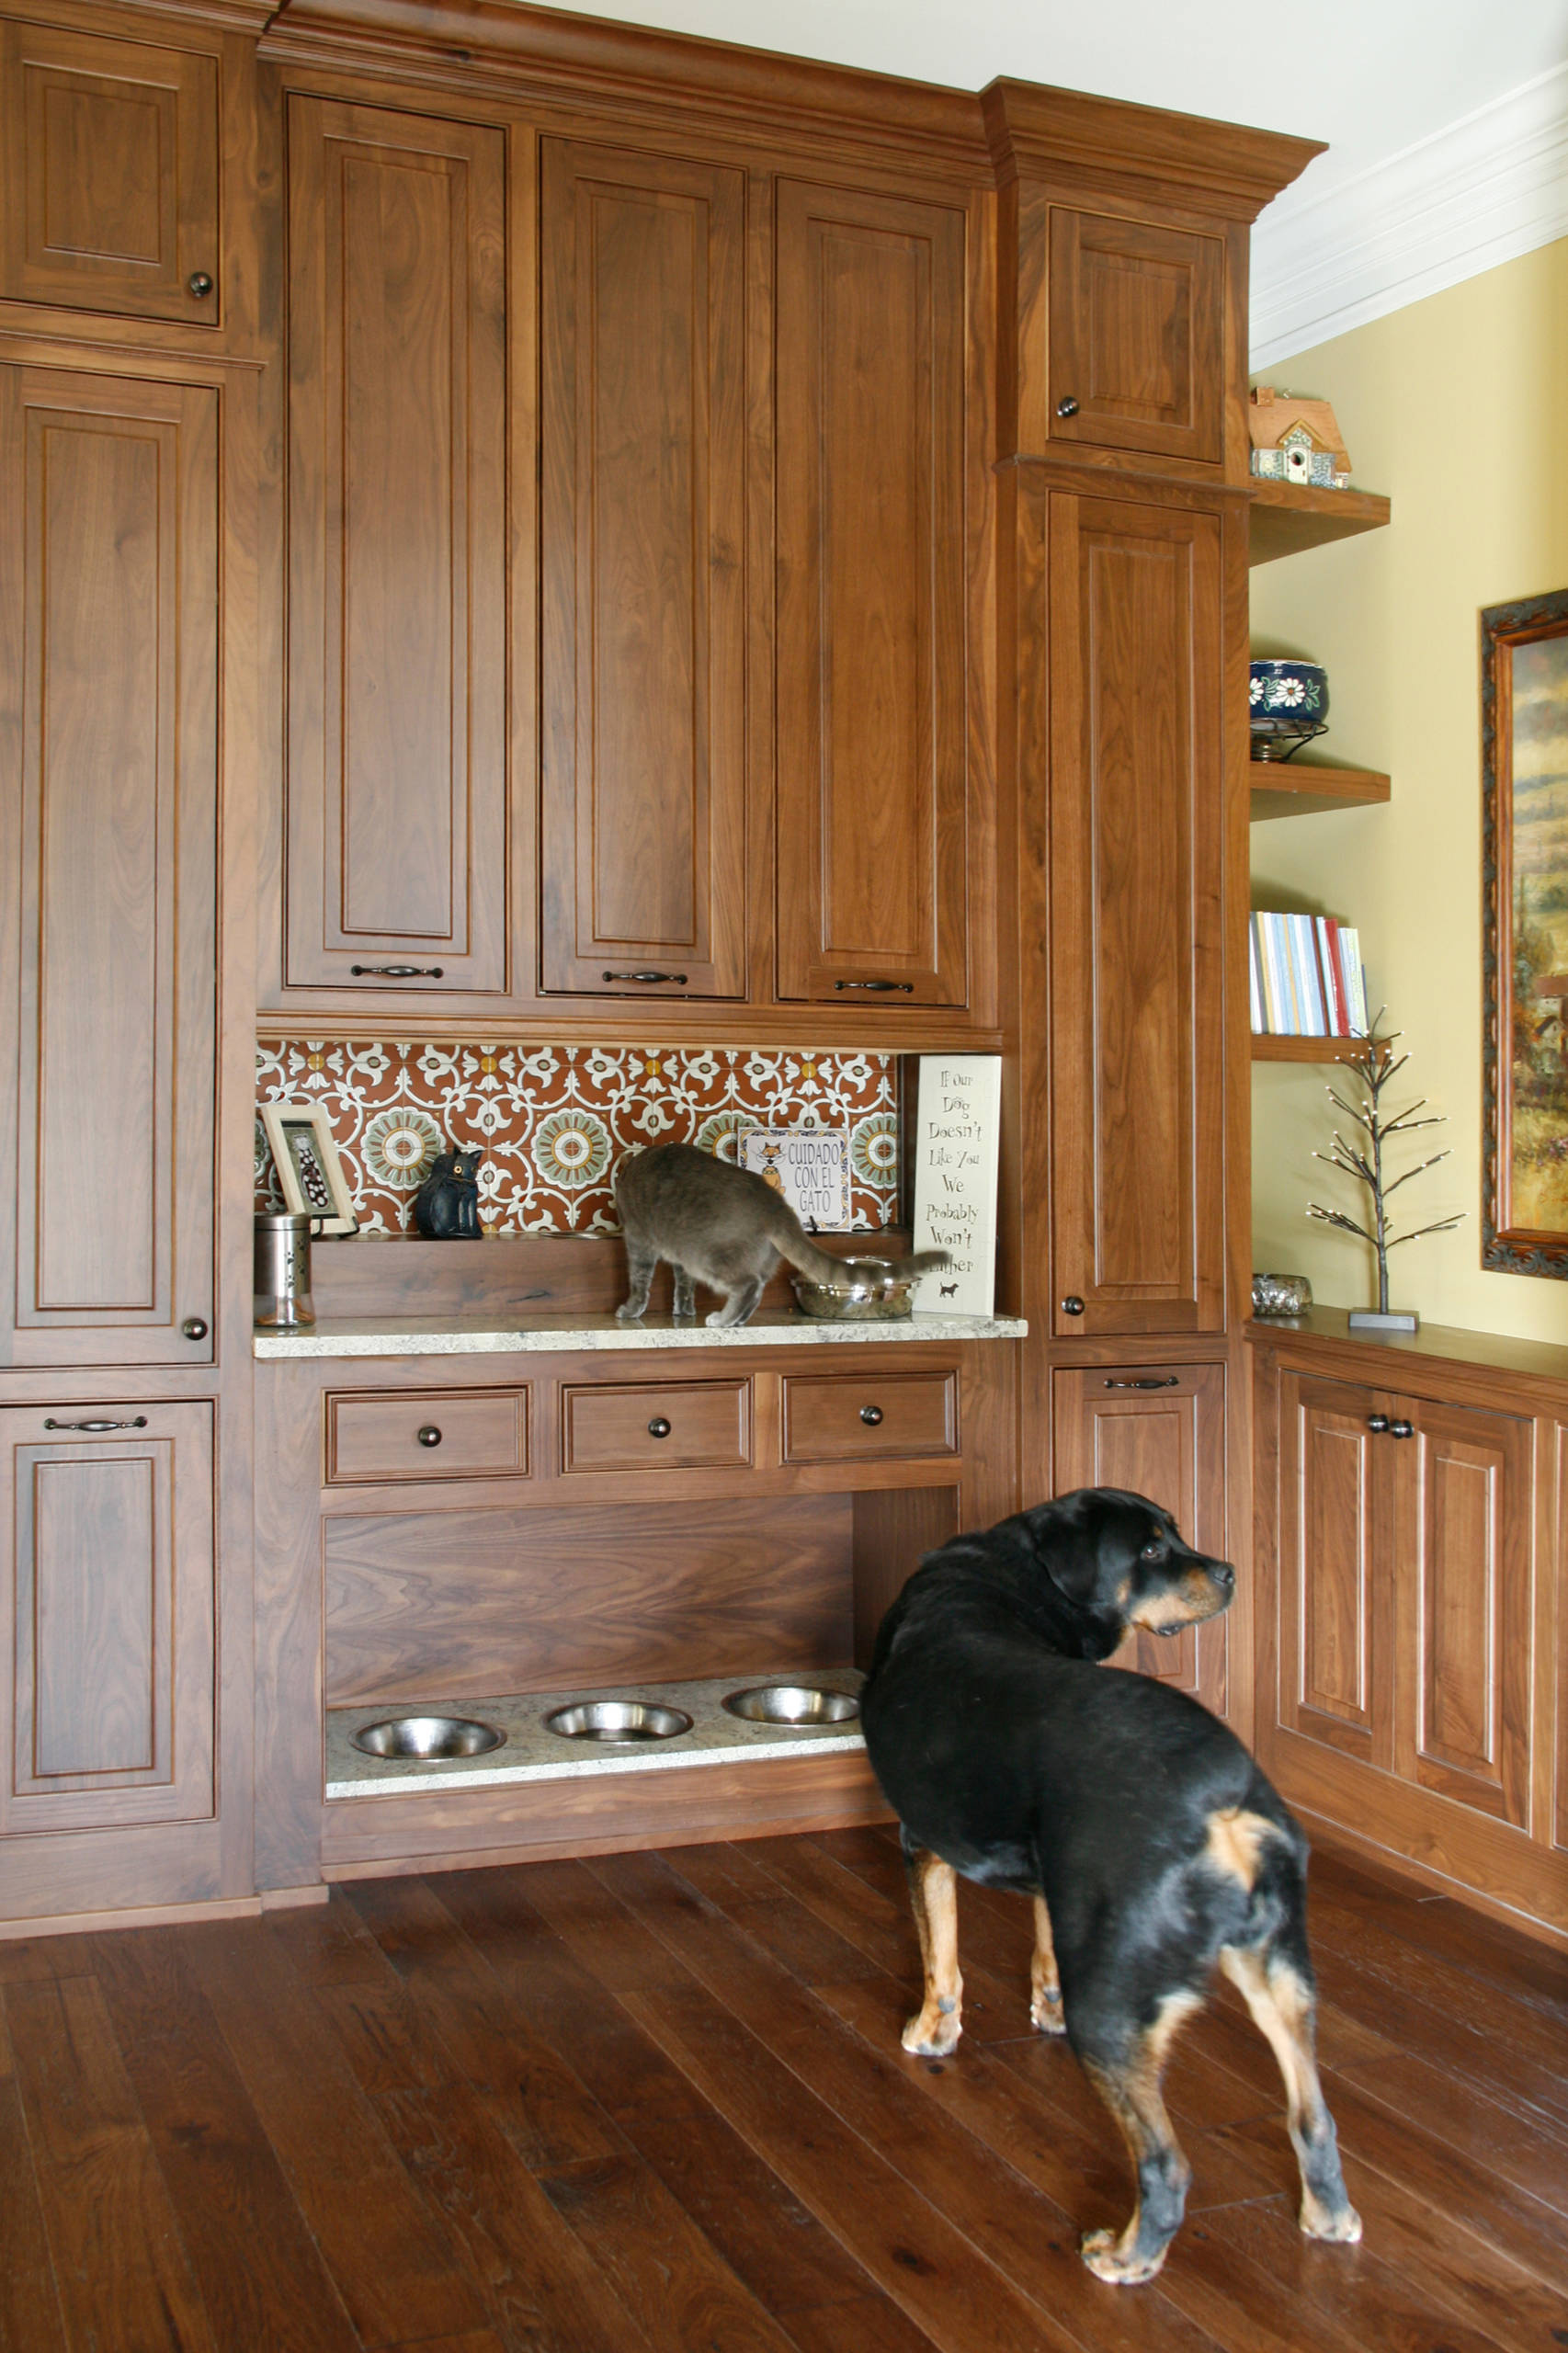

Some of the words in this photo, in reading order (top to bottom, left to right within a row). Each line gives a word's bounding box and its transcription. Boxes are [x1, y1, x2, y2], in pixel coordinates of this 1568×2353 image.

[953, 1073, 973, 1086] Our
[941, 1097, 971, 1120] Dog
[927, 1120, 983, 1142] Doesn't
[788, 1142, 839, 1165] CUIDADO
[928, 1147, 953, 1166] Like
[957, 1151, 980, 1168] You
[794, 1166, 818, 1188] CON
[822, 1167, 835, 1188] EL
[942, 1174, 964, 1193] We
[800, 1190, 831, 1212] GATO
[926, 1203, 978, 1224] Probably
[930, 1226, 971, 1249] Won't
